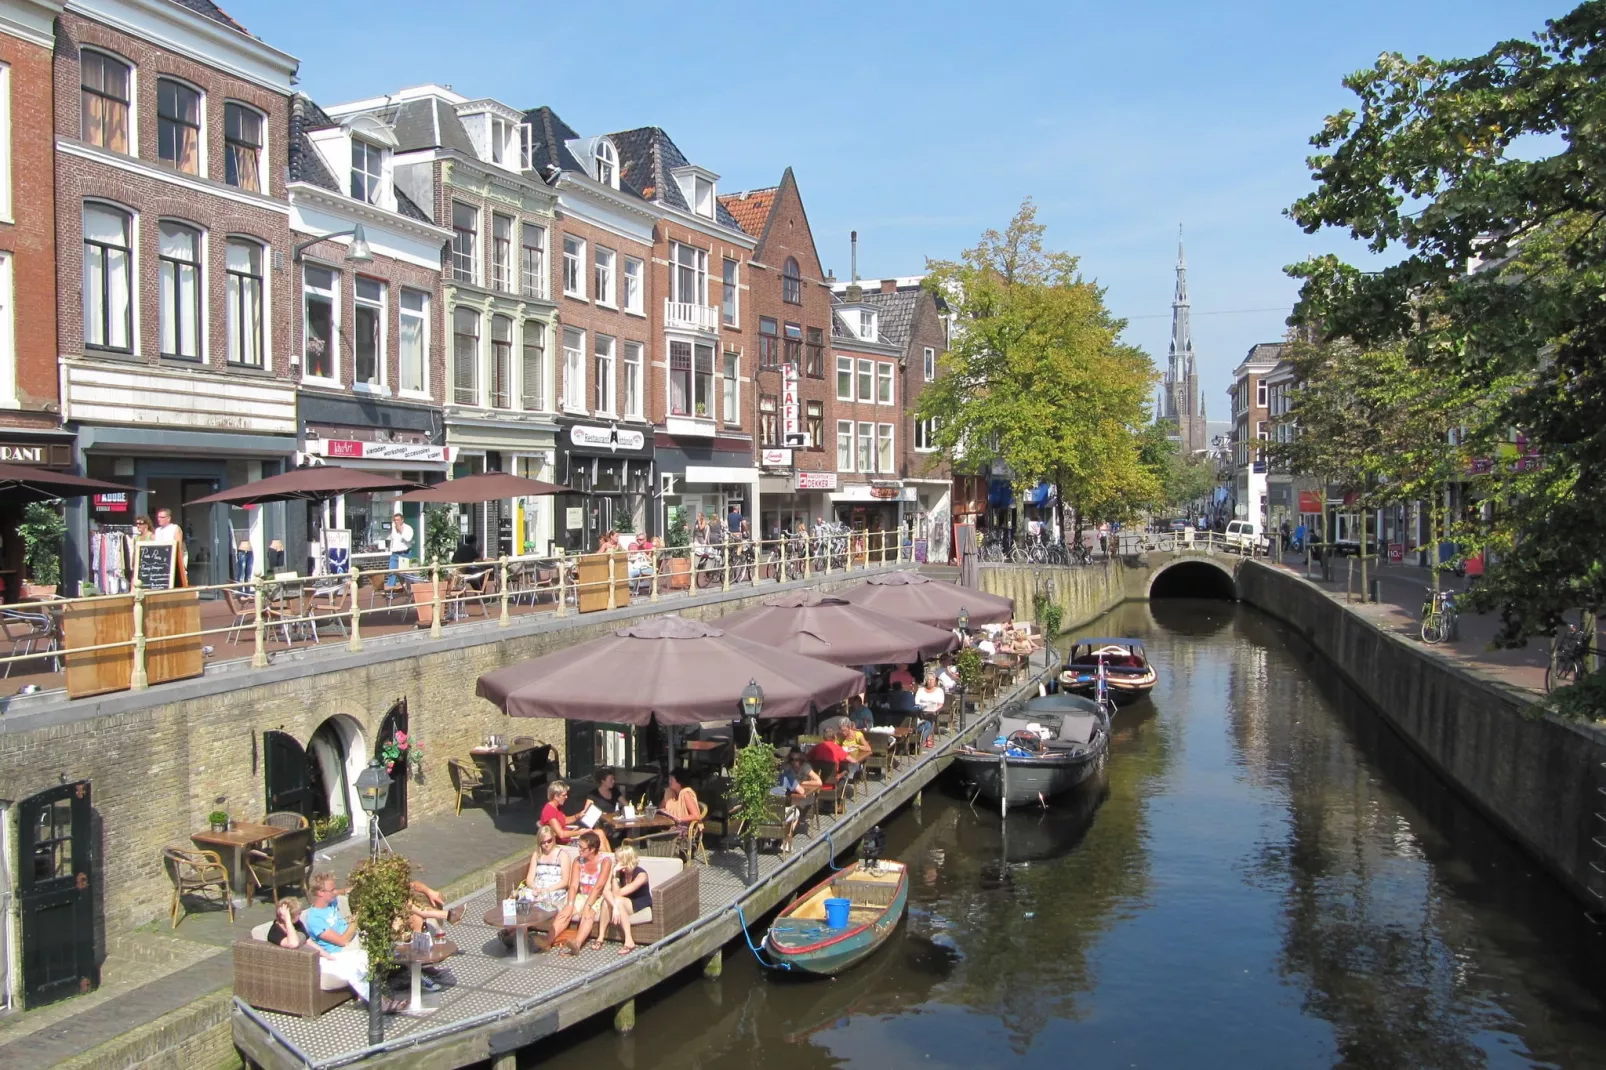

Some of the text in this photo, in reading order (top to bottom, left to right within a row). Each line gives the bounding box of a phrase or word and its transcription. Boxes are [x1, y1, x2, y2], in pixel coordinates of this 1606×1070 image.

[384, 447, 408, 457] workshops
[404, 448, 431, 458] accessoires
[808, 480, 829, 488] DEKKER
